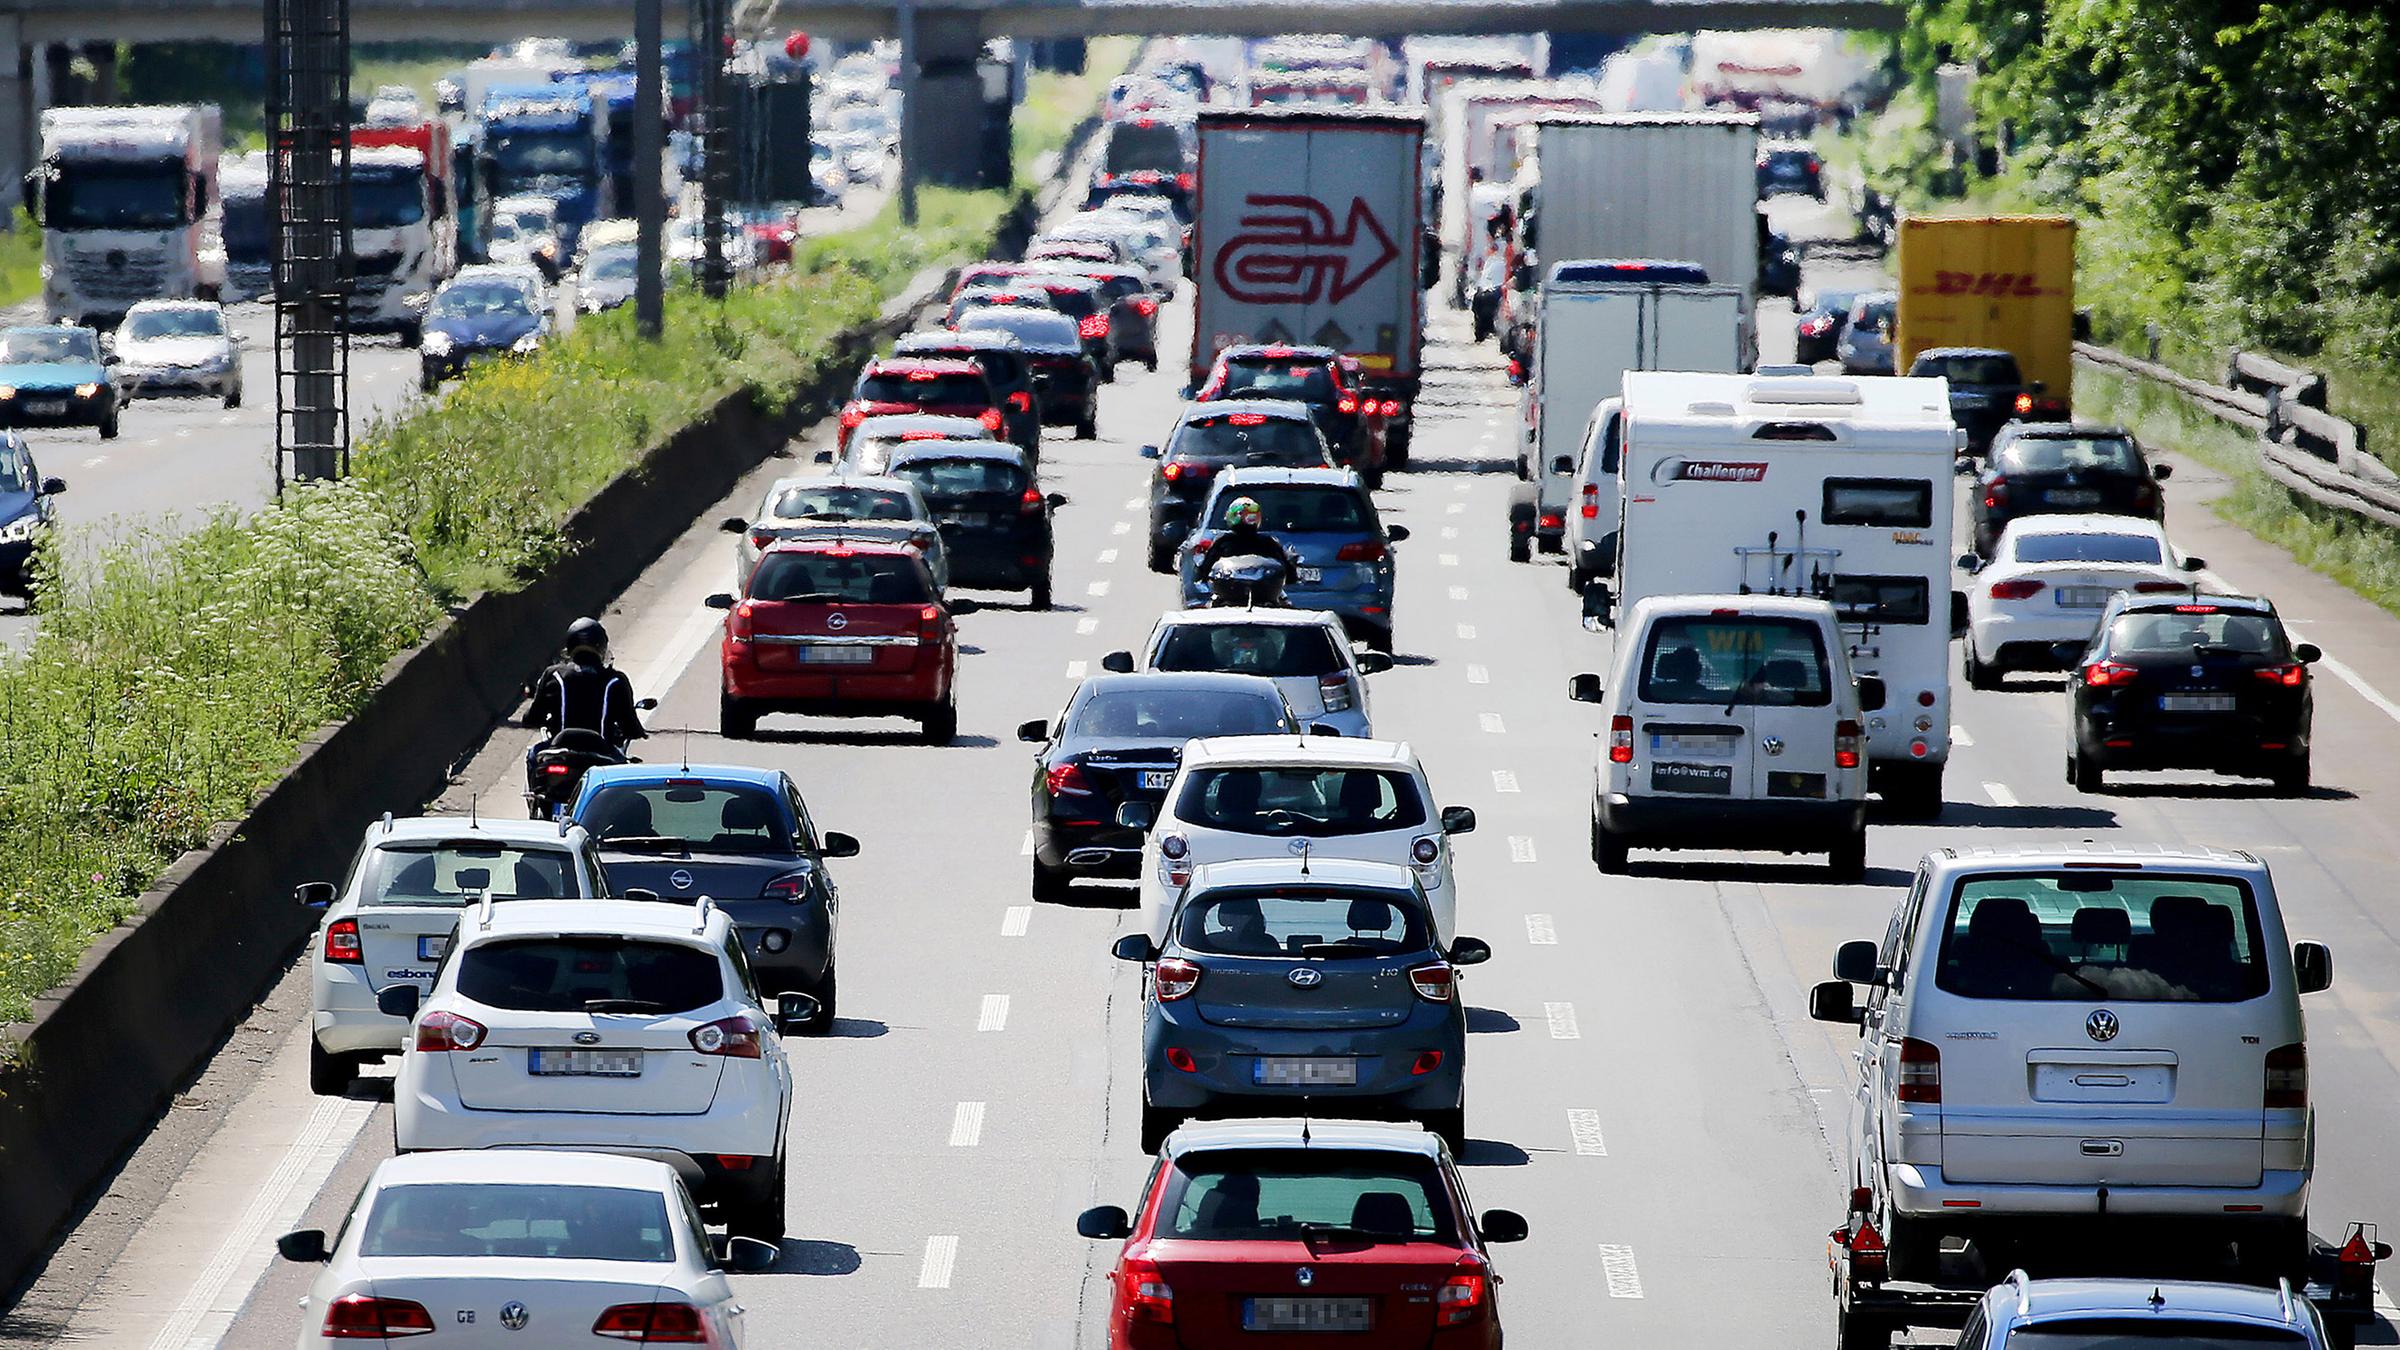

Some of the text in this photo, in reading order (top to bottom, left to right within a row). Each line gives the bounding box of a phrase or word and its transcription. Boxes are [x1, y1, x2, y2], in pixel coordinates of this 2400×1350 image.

[1936, 271, 2042, 296] DHL
[1686, 463, 1761, 481] Challenger
[1706, 630, 1764, 652] WM
[1655, 766, 1728, 779] info@wm.de
[1147, 773, 1156, 787] K
[2241, 1036, 2260, 1044] TDI
[457, 1310, 476, 1324] GB
